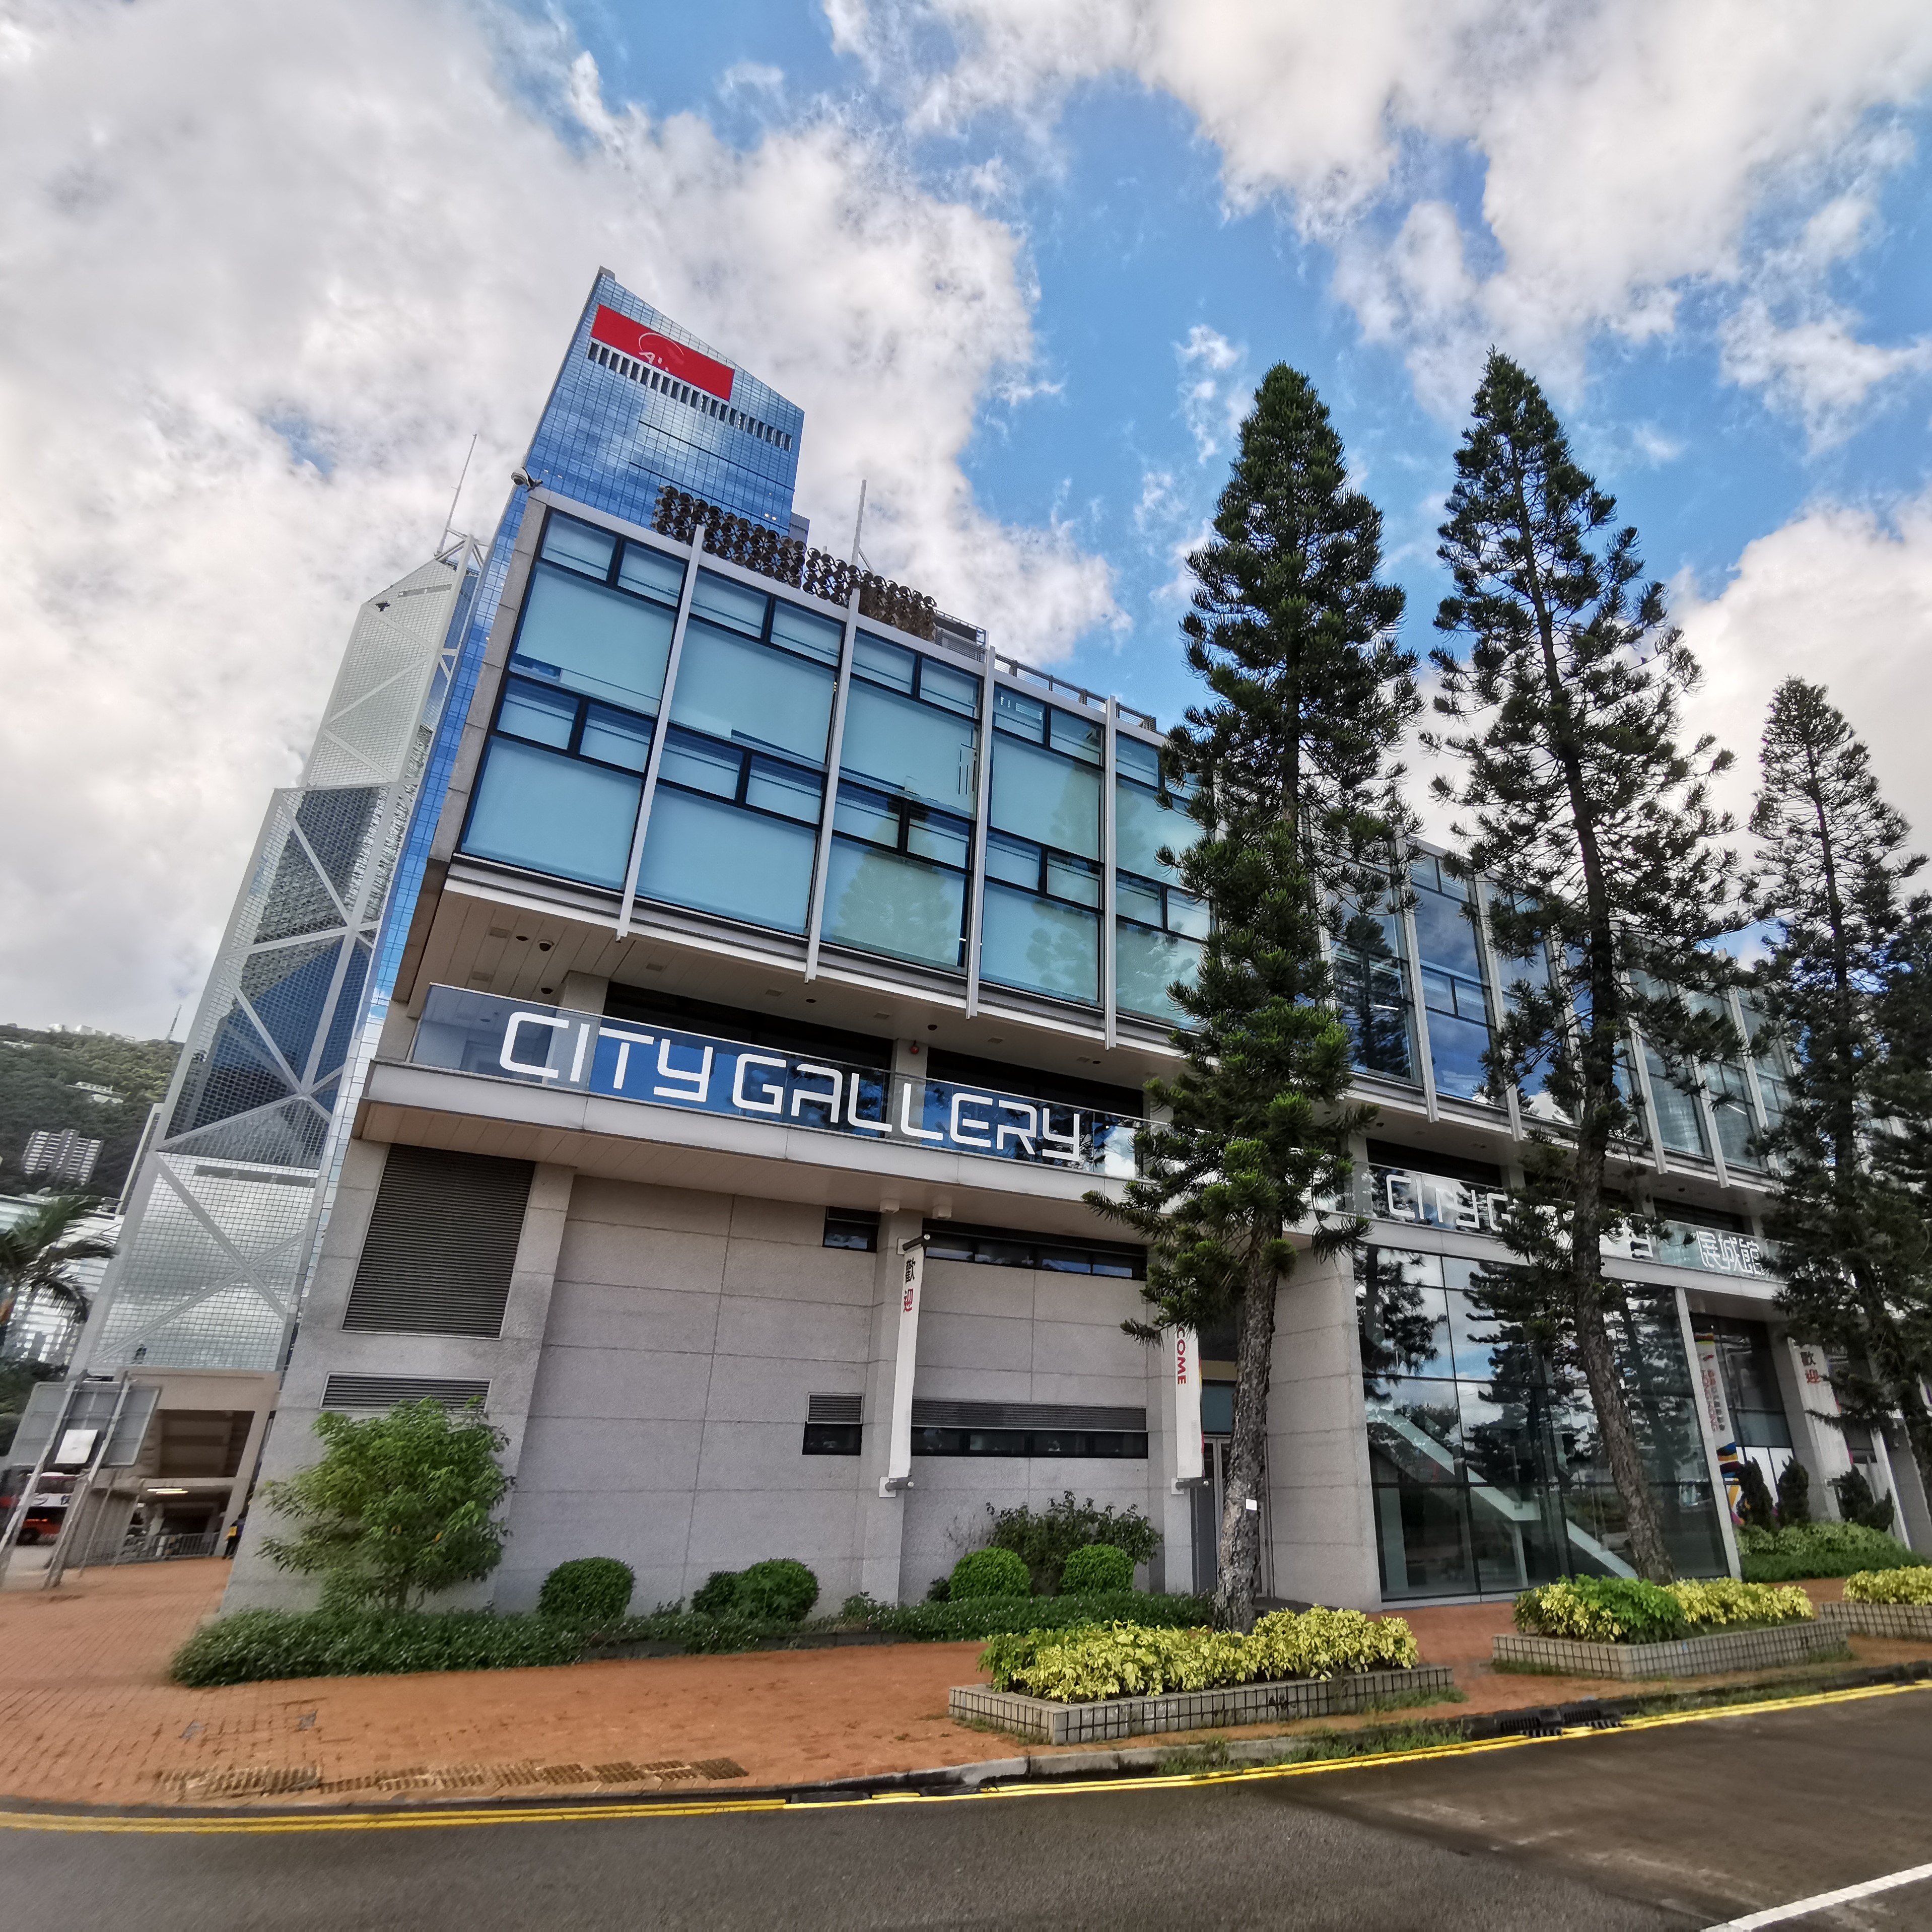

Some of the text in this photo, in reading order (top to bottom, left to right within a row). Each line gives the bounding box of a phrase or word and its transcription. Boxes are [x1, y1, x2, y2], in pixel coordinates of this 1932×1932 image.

[499, 1011, 1080, 1161] CITY GALLERY
[1386, 1174, 1480, 1229] CITY
[903, 1257, 916, 1314] 歡迎
[1177, 1327, 1187, 1385] COME
